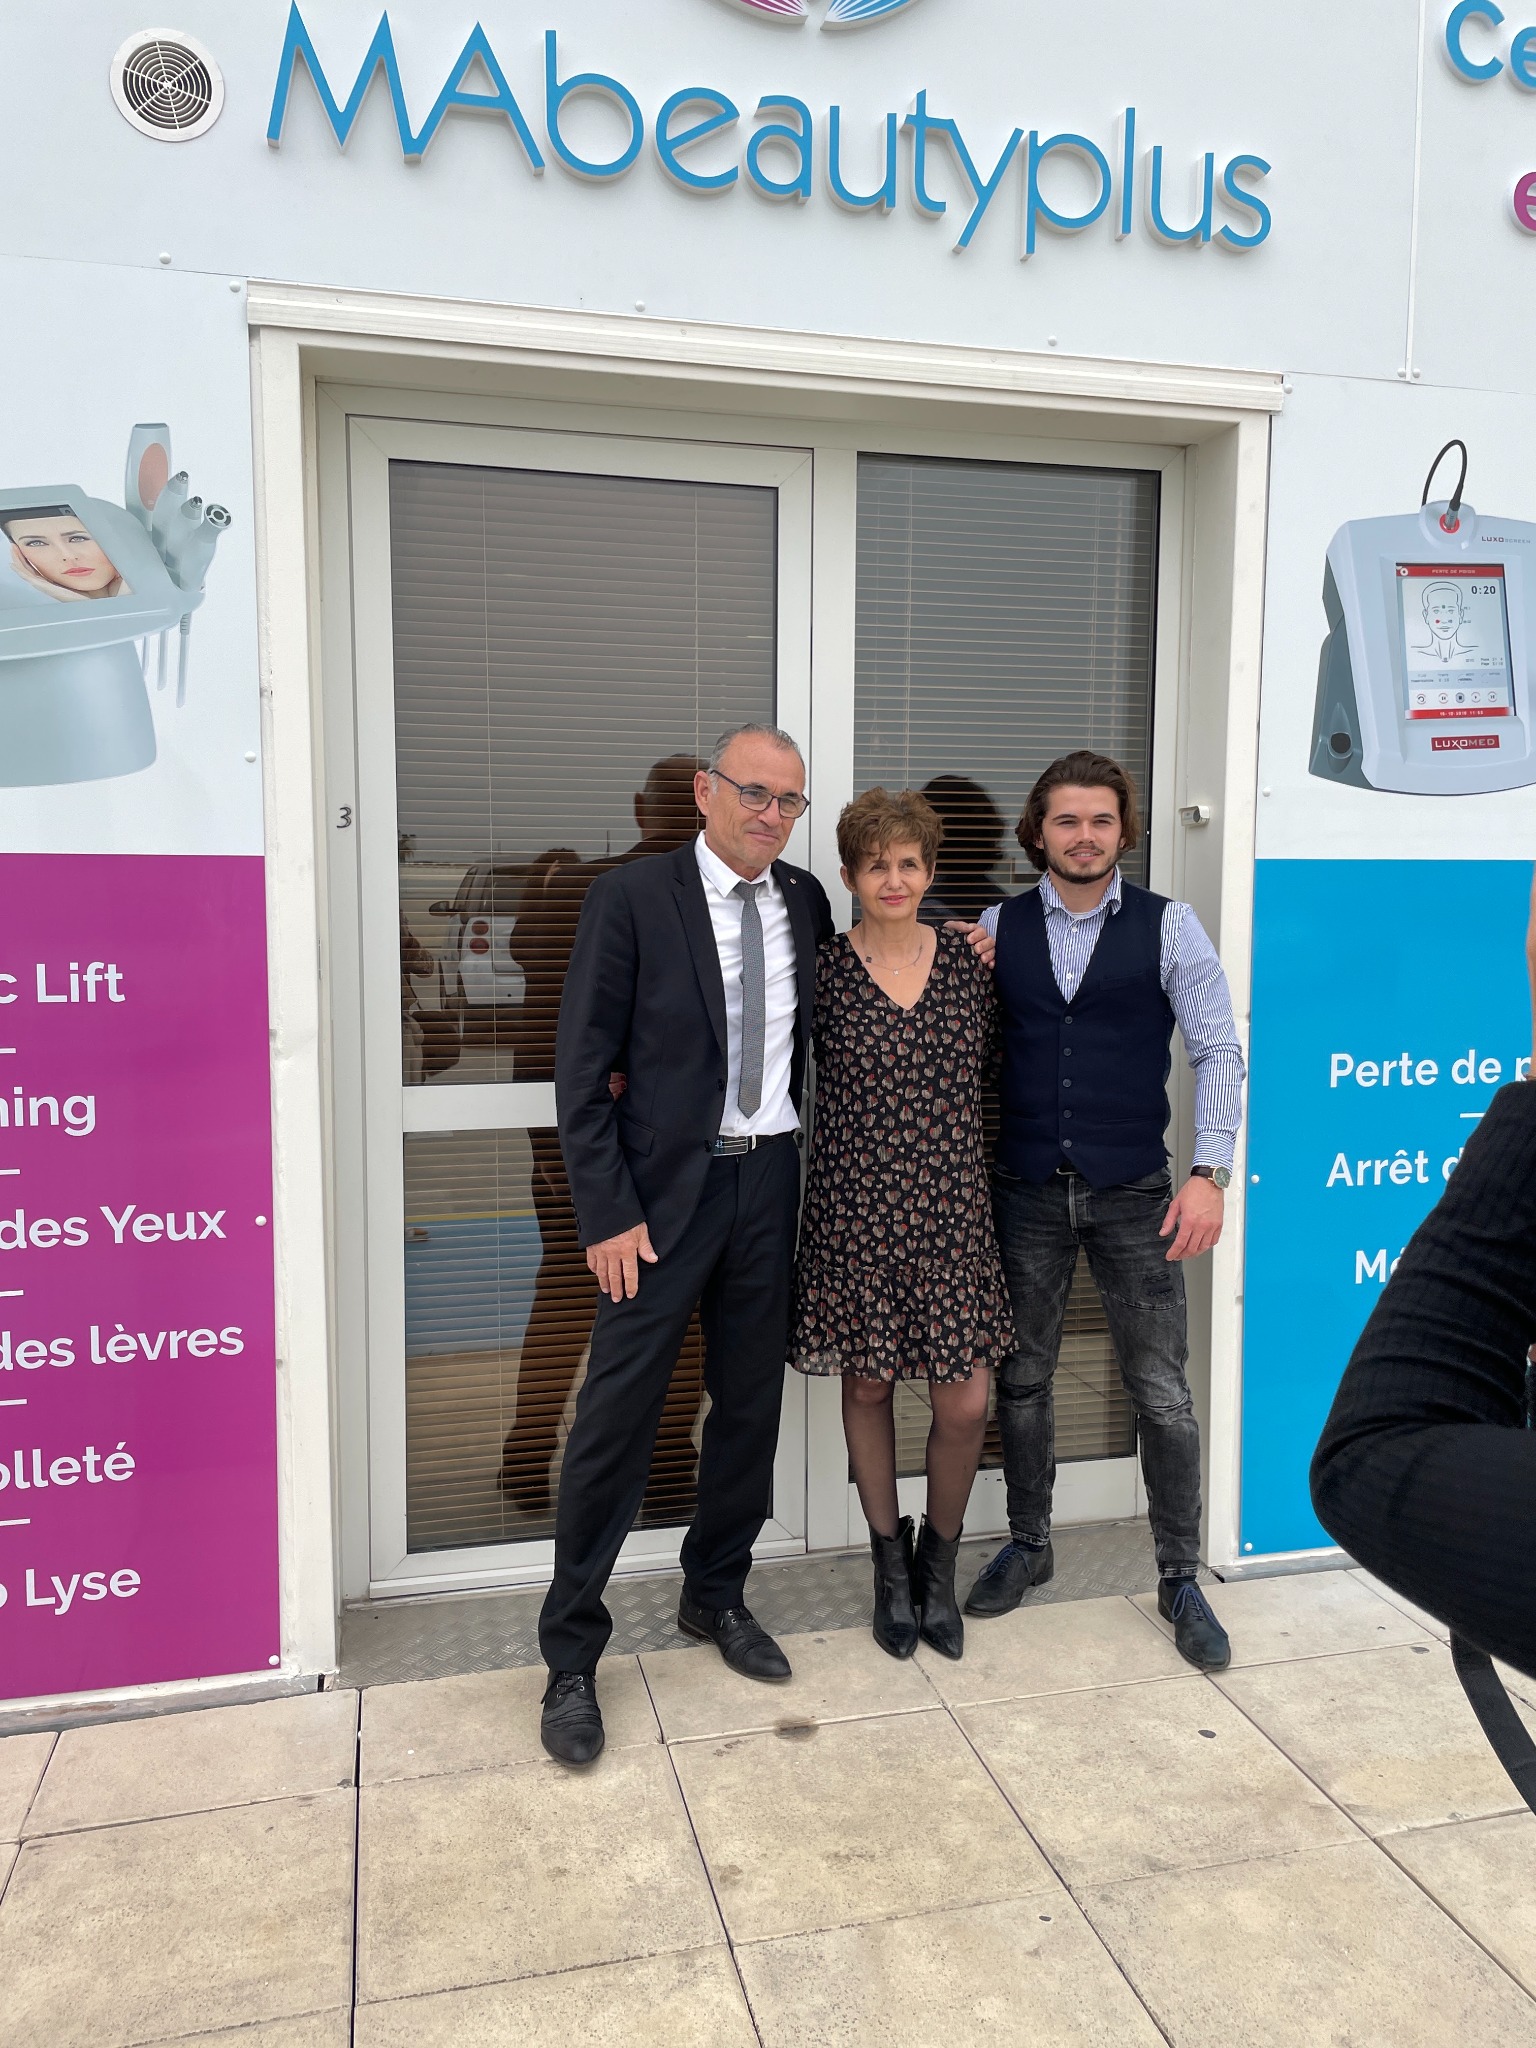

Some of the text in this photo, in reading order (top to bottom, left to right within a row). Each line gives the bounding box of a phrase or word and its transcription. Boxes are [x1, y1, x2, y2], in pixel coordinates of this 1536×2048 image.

[267, 0, 1273, 257] MAbeautyplus
[1471, 585, 1496, 595] 0:20
[1434, 738, 1495, 750] LUXOMED
[336, 806, 352, 829] 3
[36, 961, 126, 1003] Lift
[1330, 1052, 1439, 1088] Perte
[1451, 1049, 1501, 1085] de
[1326, 1149, 1429, 1187] Arrêt
[0, 1204, 227, 1250] des Yeux
[90, 1323, 245, 1365] lèvres
[25, 1568, 141, 1616] Lyse
